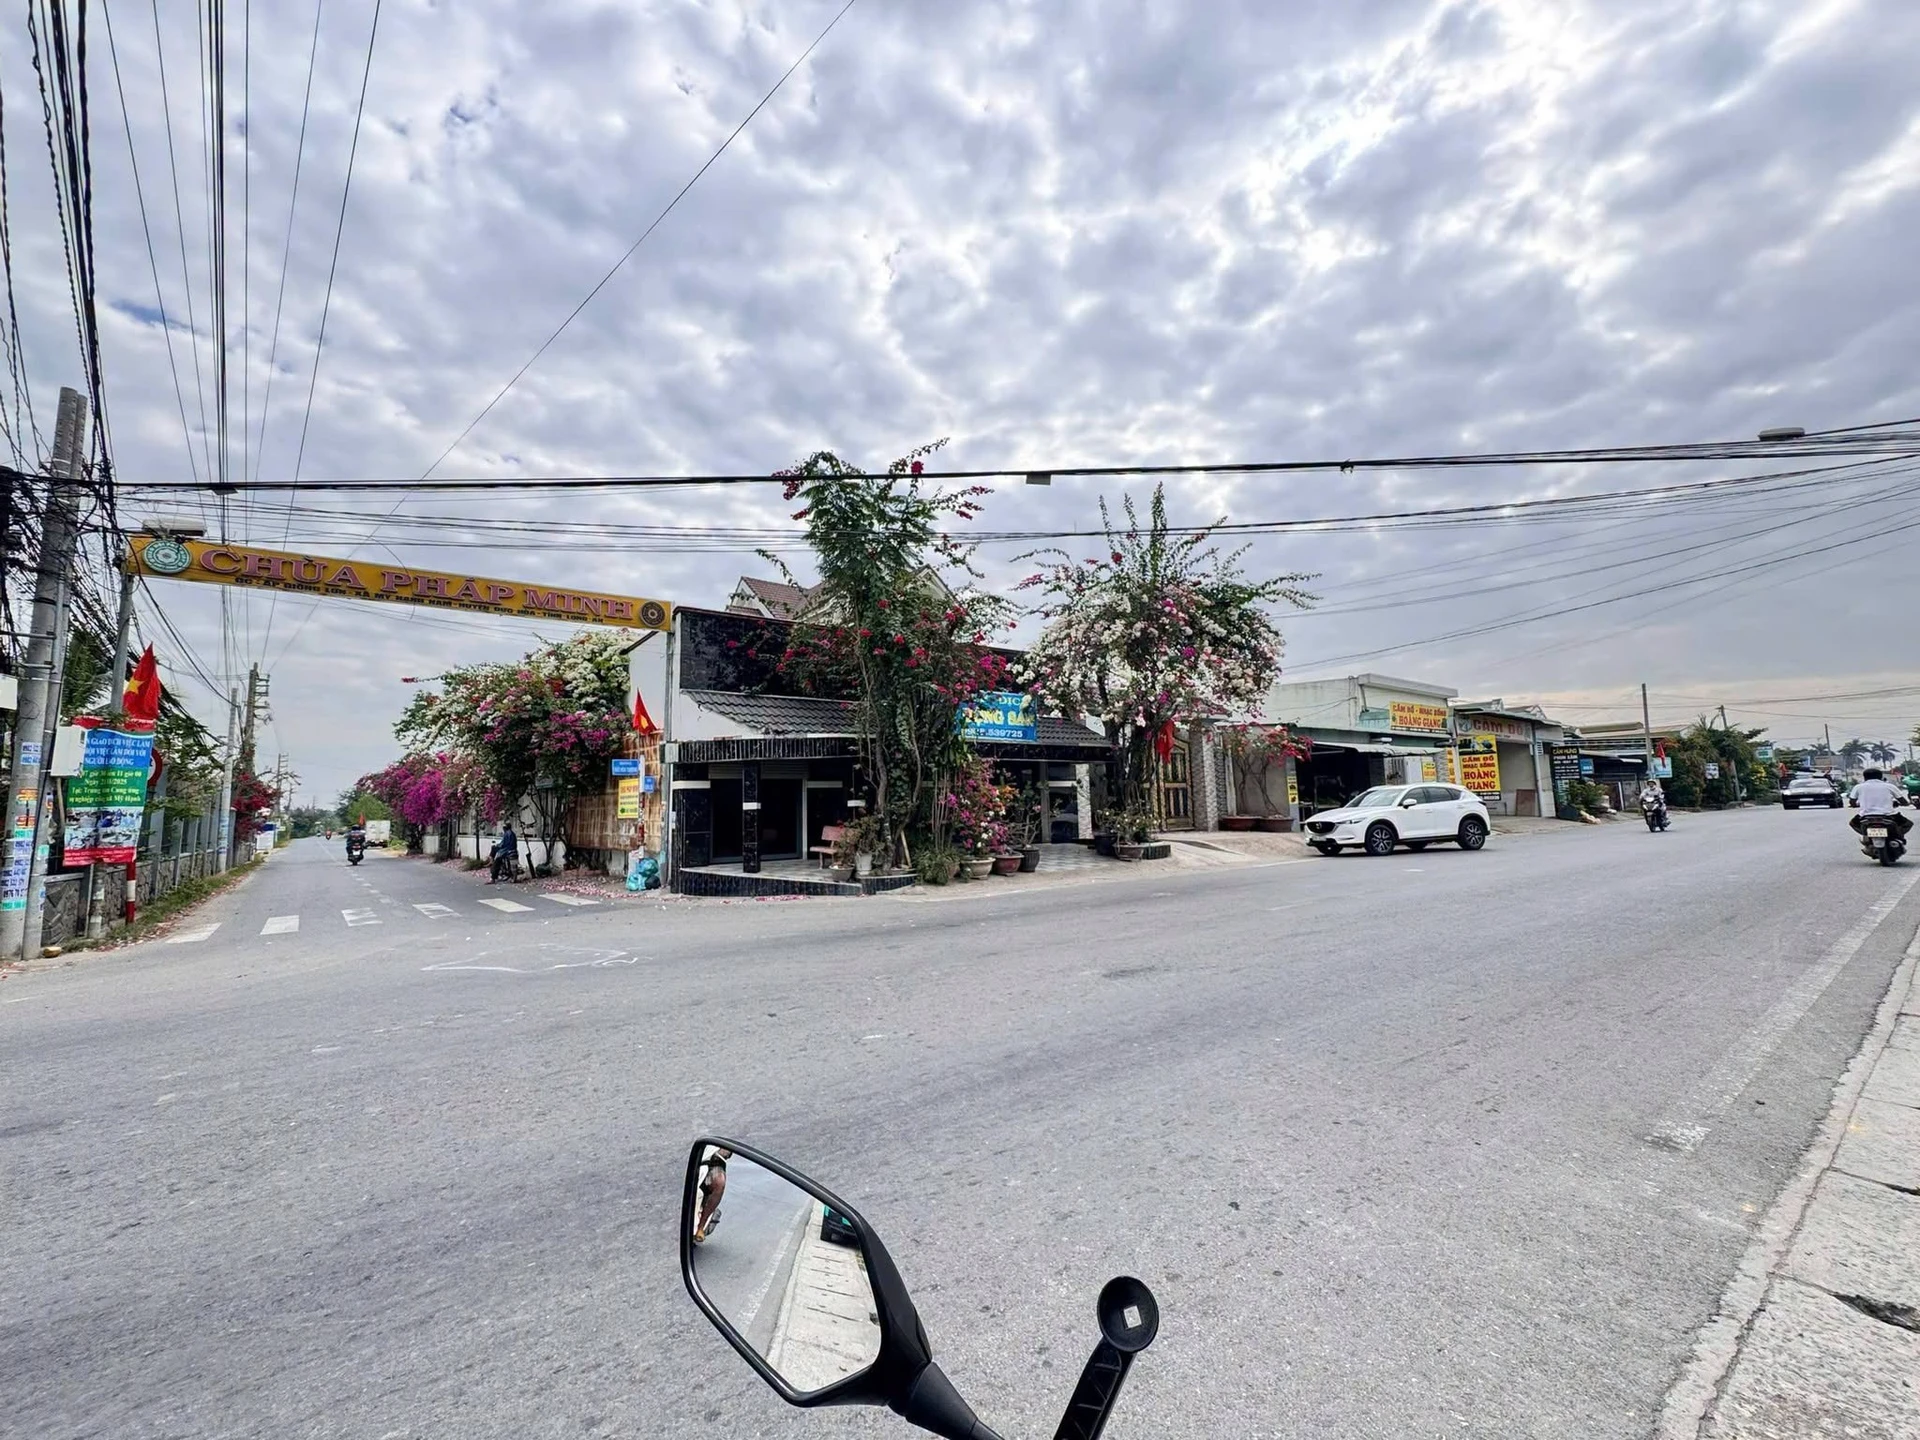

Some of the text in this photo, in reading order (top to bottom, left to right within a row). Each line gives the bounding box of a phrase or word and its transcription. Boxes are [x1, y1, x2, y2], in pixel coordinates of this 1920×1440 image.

[200, 550, 365, 589] CHÙA
[381, 570, 515, 604] PHÁP
[523, 588, 634, 620] MINH
[1463, 769, 1496, 780] HOÀNG
[1466, 781, 1496, 790] GIANG
